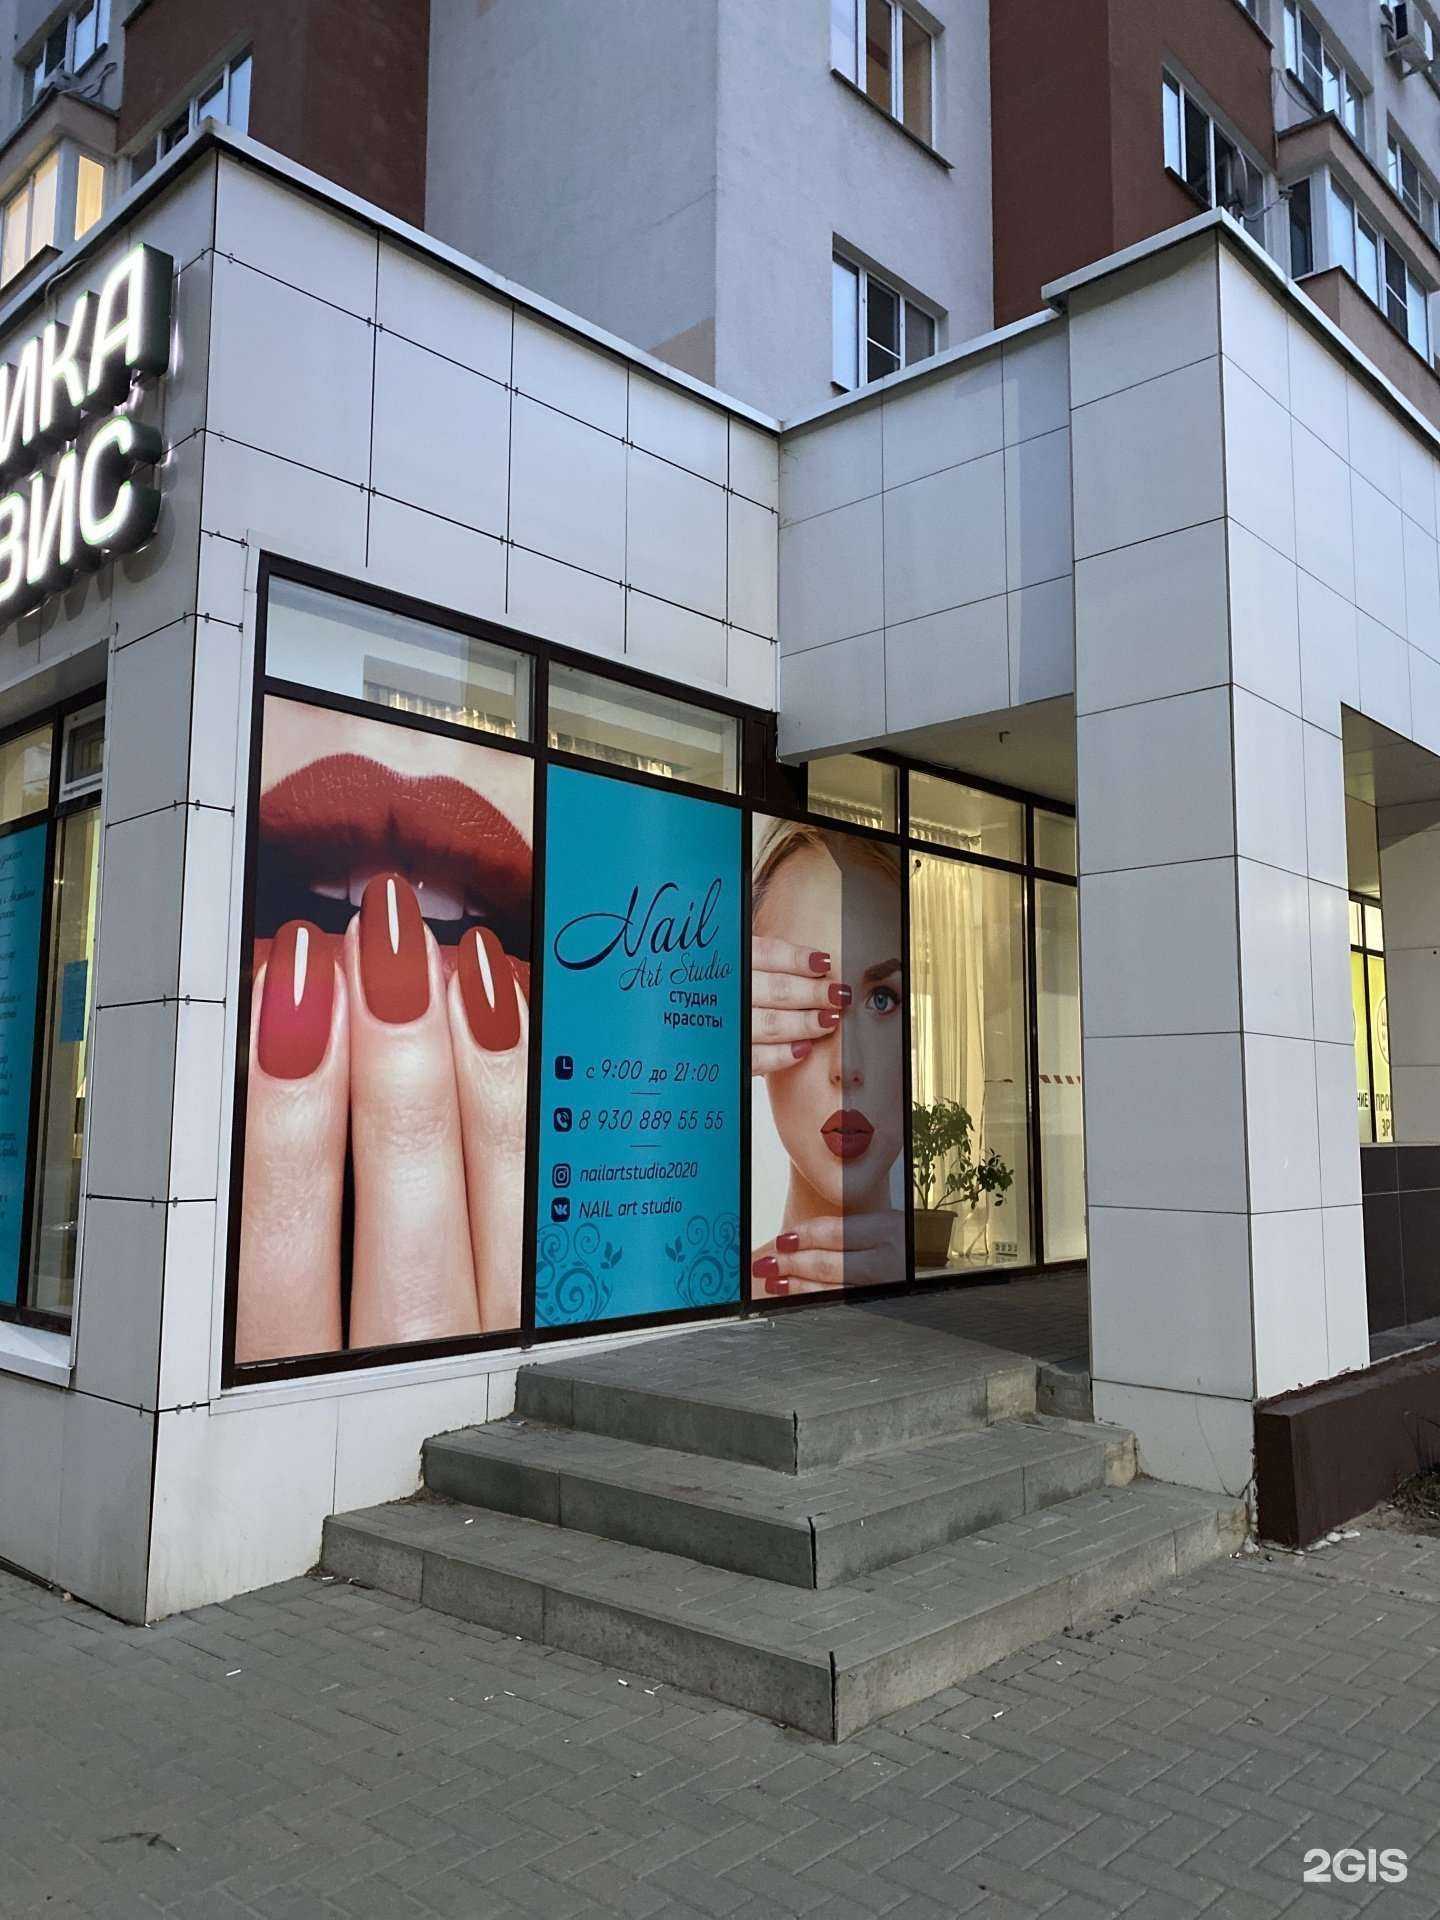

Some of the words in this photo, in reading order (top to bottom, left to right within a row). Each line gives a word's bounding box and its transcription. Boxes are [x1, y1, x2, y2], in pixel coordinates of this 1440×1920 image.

[553, 877, 723, 971] Nail
[618, 956, 663, 992] Art
[670, 950, 731, 985] Studio
[669, 990, 718, 1008] студия
[663, 1011, 723, 1029] красоты
[601, 1059, 643, 1080] 9:00
[648, 1070, 668, 1084] до
[673, 1062, 720, 1083] 21:00
[578, 1109, 592, 1131] 8
[597, 1109, 633, 1131] 930
[639, 1110, 673, 1131] 889
[677, 1110, 699, 1131] 55
[703, 1110, 726, 1131] 55
[579, 1161, 699, 1183] nailartstudio2020
[578, 1200, 615, 1219] NAIL
[617, 1200, 640, 1216] art
[640, 1196, 684, 1214] studio
